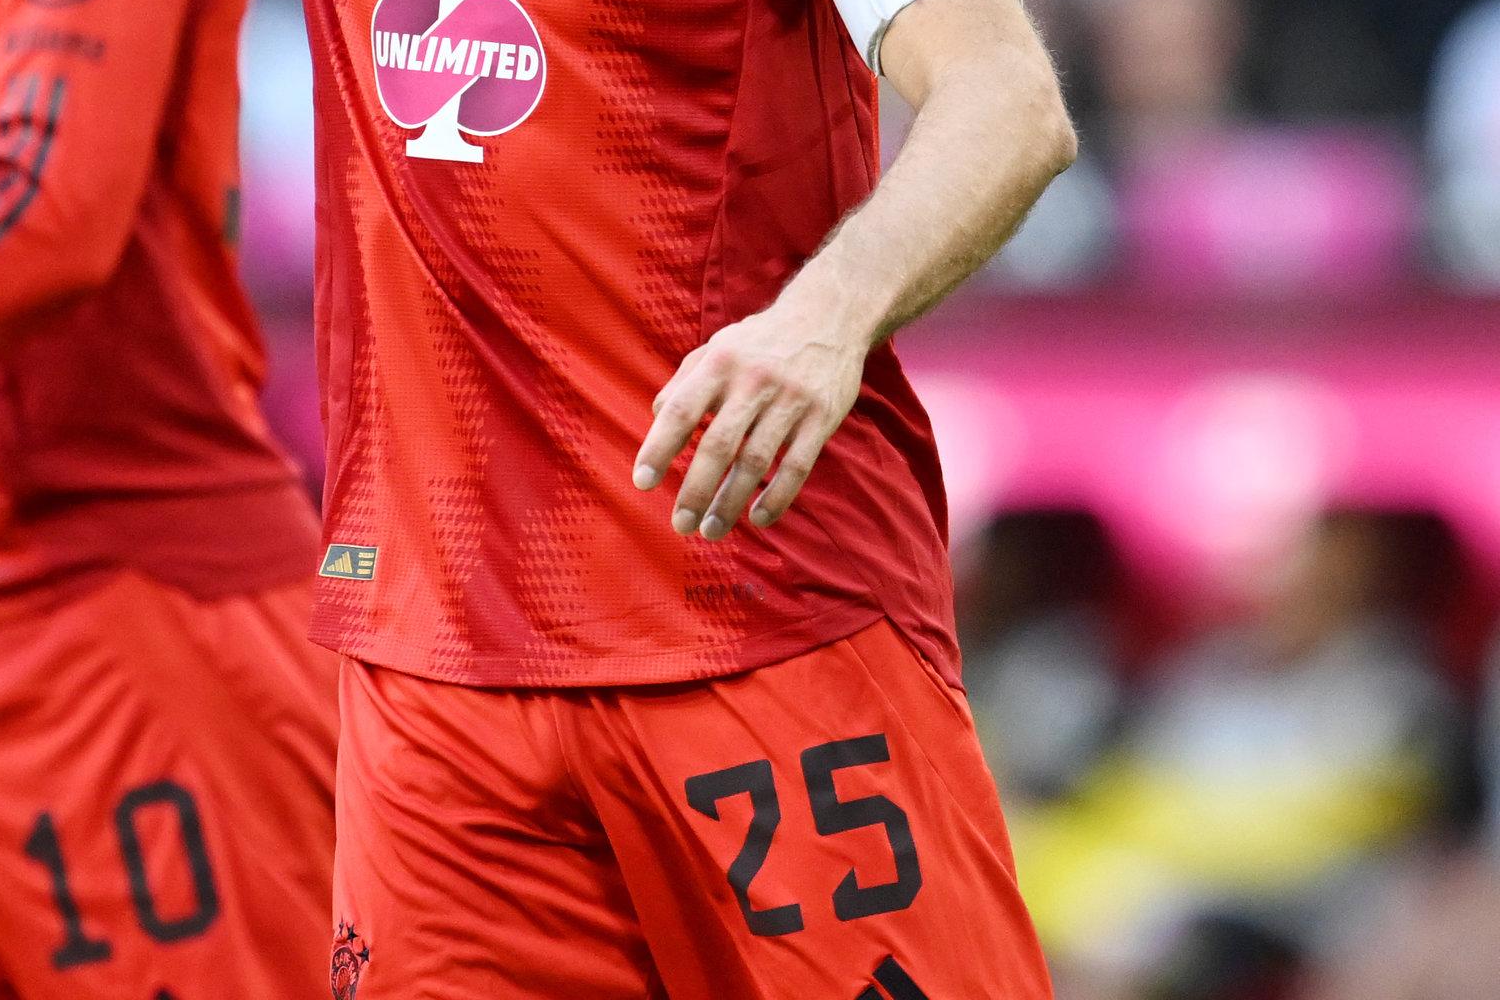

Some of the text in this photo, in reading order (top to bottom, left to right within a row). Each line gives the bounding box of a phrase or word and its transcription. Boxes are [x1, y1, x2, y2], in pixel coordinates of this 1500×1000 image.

[375, 30, 539, 81] UNLIMITED
[24, 778, 220, 970] 10
[684, 733, 923, 937] 25
